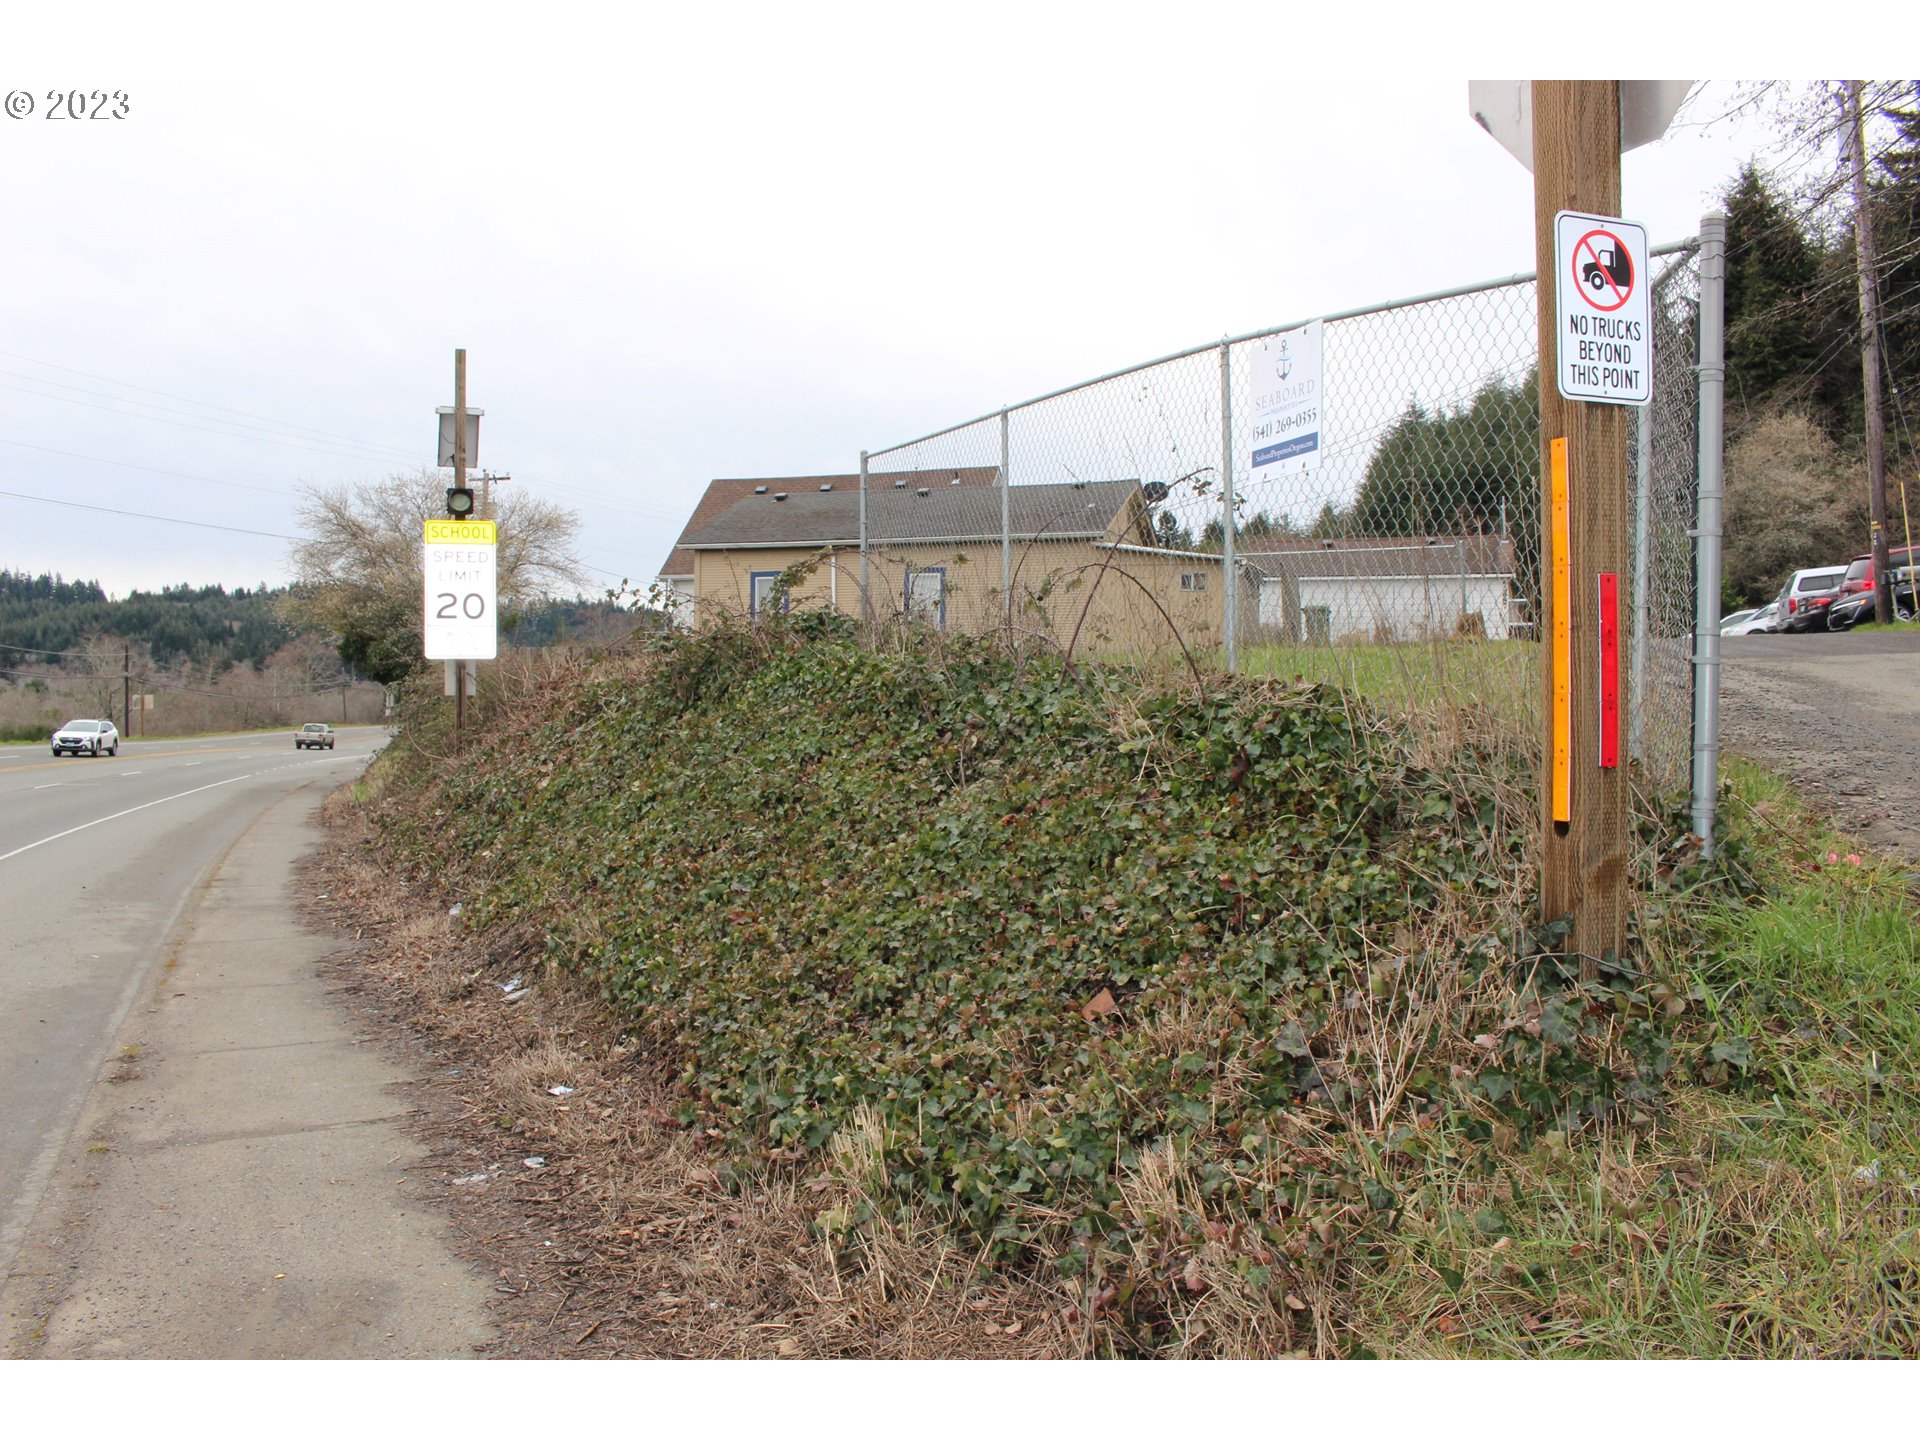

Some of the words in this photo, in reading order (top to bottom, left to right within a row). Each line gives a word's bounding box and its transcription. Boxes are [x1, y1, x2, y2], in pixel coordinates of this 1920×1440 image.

[1570, 314, 1588, 335] NO
[1591, 316, 1641, 341] TRUCKS
[1579, 340, 1631, 364] BEYOND
[1570, 364, 1599, 386] THIS
[1603, 368, 1640, 390] POINT
[1255, 379, 1315, 410] SEABOARD
[1252, 420, 1273, 443] (541)
[1275, 408, 1317, 434] 269-0355
[431, 526, 490, 539] SCHOOL
[433, 551, 488, 563] SPEED
[438, 570, 481, 582] LIMIT
[436, 593, 485, 619] 20
